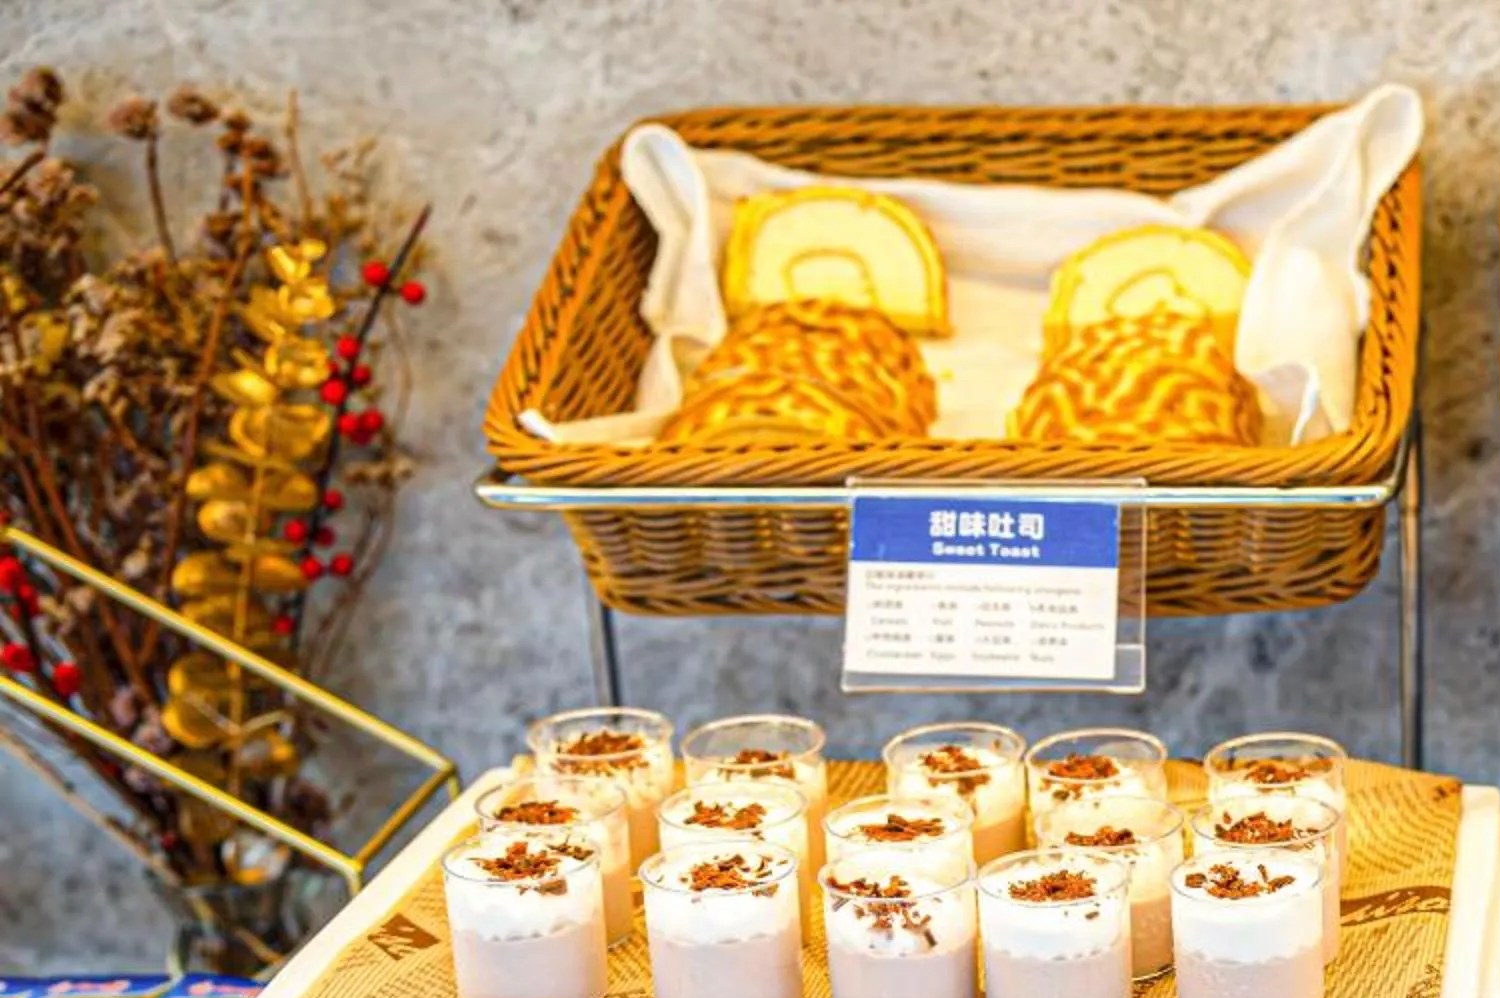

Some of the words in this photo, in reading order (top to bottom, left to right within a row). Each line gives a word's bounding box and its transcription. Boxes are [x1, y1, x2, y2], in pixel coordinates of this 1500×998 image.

[929, 510, 1044, 540] 甜味吐司
[932, 541, 985, 556] Sweet
[989, 543, 1040, 558] Toast
